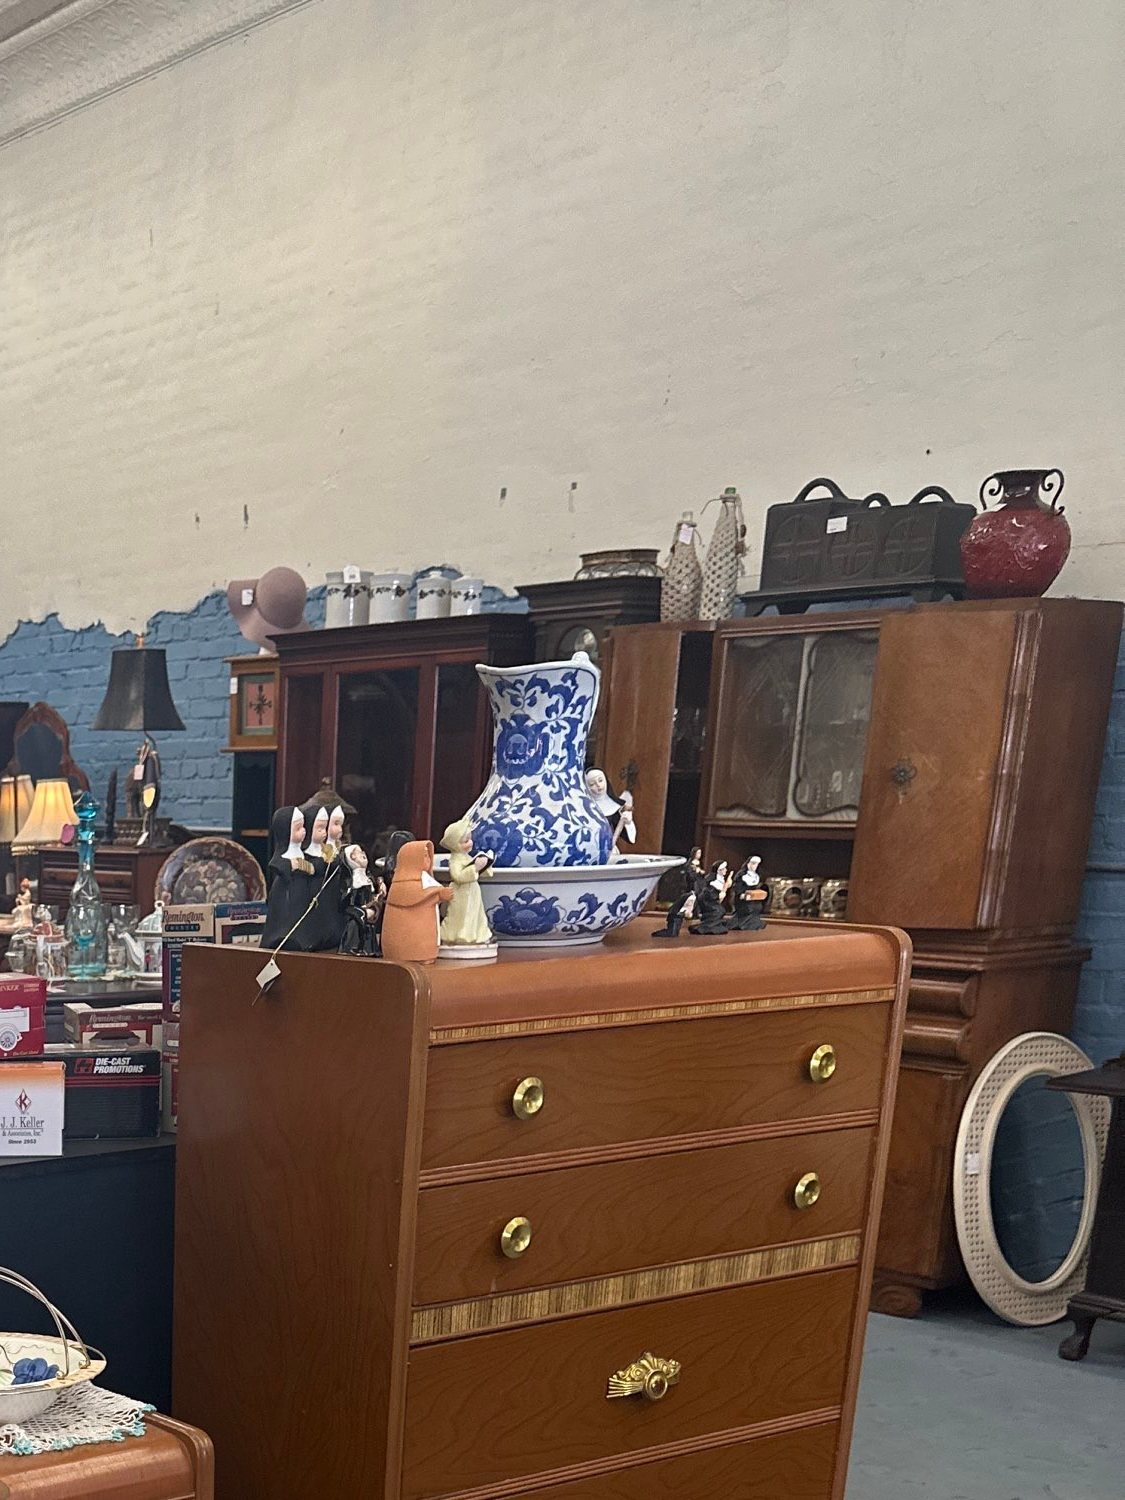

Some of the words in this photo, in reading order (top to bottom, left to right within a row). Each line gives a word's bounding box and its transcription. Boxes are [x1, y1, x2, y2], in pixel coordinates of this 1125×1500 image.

[162, 909, 205, 924] Remington
[95, 1057, 132, 1066] DIE-CAST
[93, 1065, 144, 1074] PROMOTIONS
[0, 1117, 9, 1129] J.
[10, 1117, 18, 1129] J.
[20, 1116, 45, 1128] Keller
